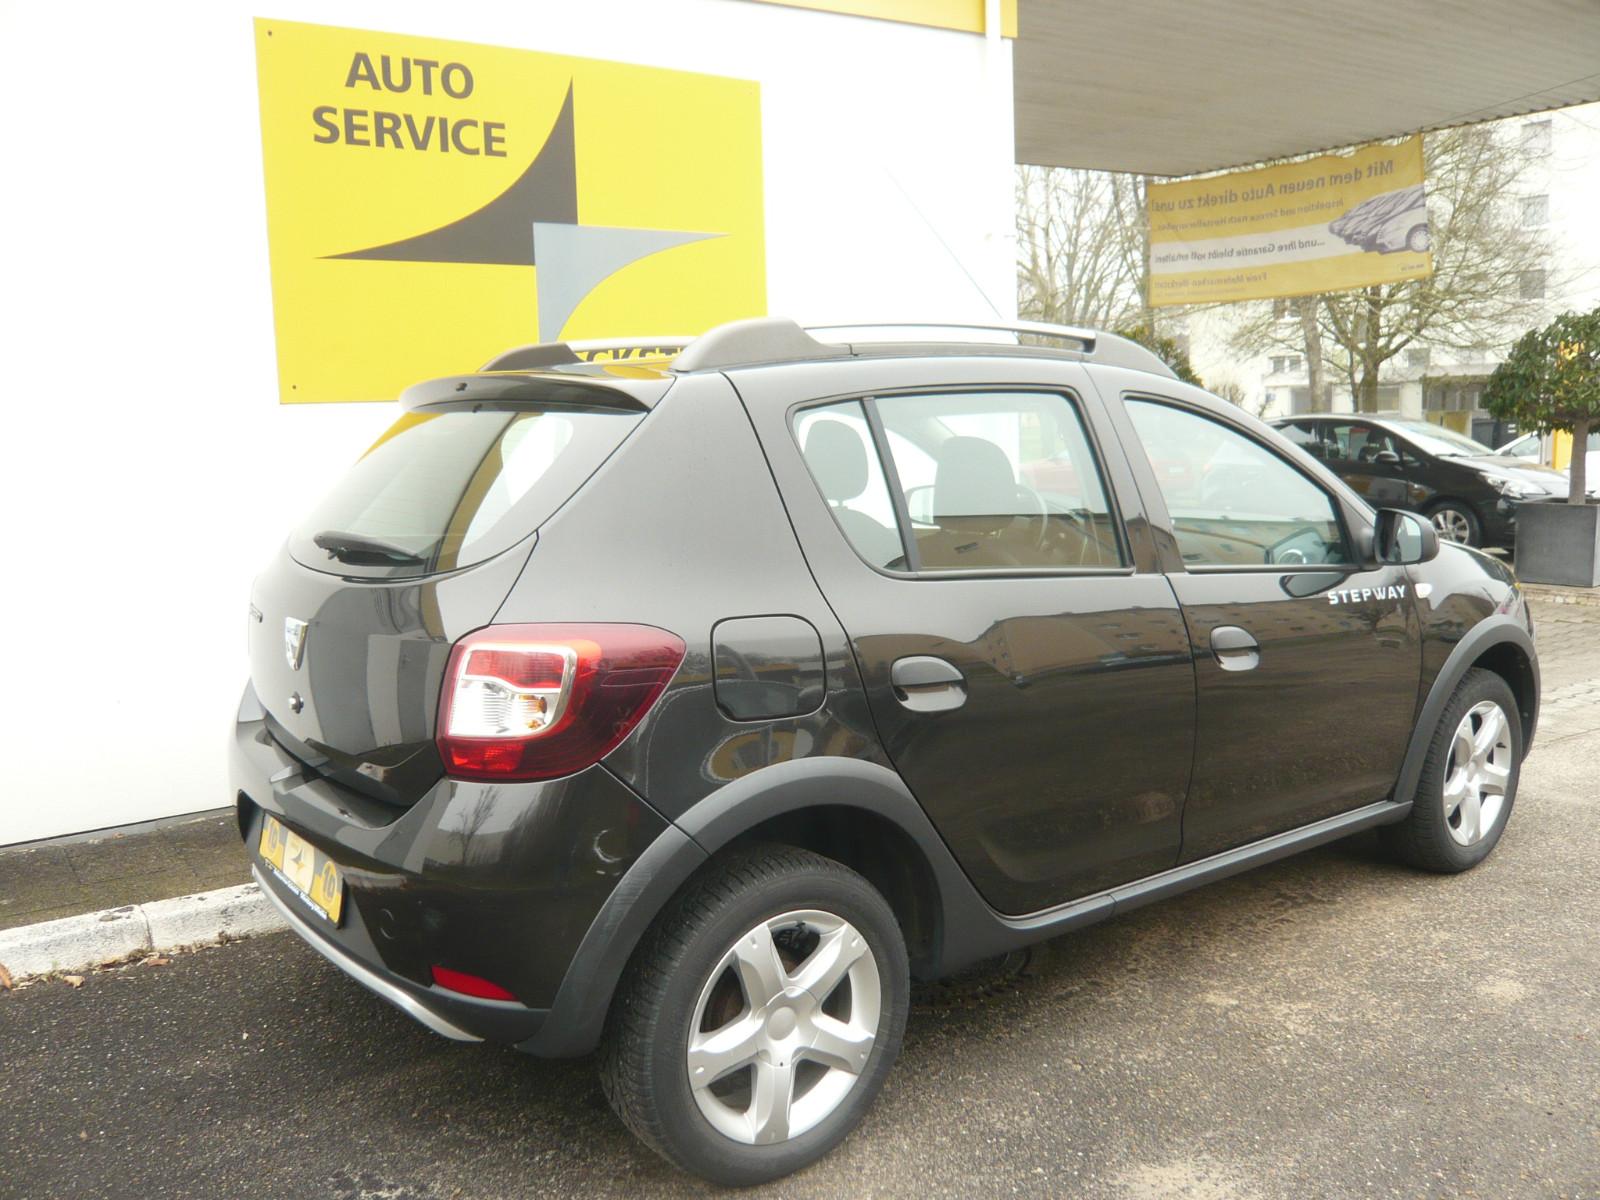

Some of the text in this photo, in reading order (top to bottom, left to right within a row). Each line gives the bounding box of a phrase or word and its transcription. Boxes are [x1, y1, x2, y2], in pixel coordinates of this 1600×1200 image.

[345, 51, 474, 100] AUTO
[312, 105, 507, 158] SERVICE
[1327, 584, 1406, 605] STEPWAY
